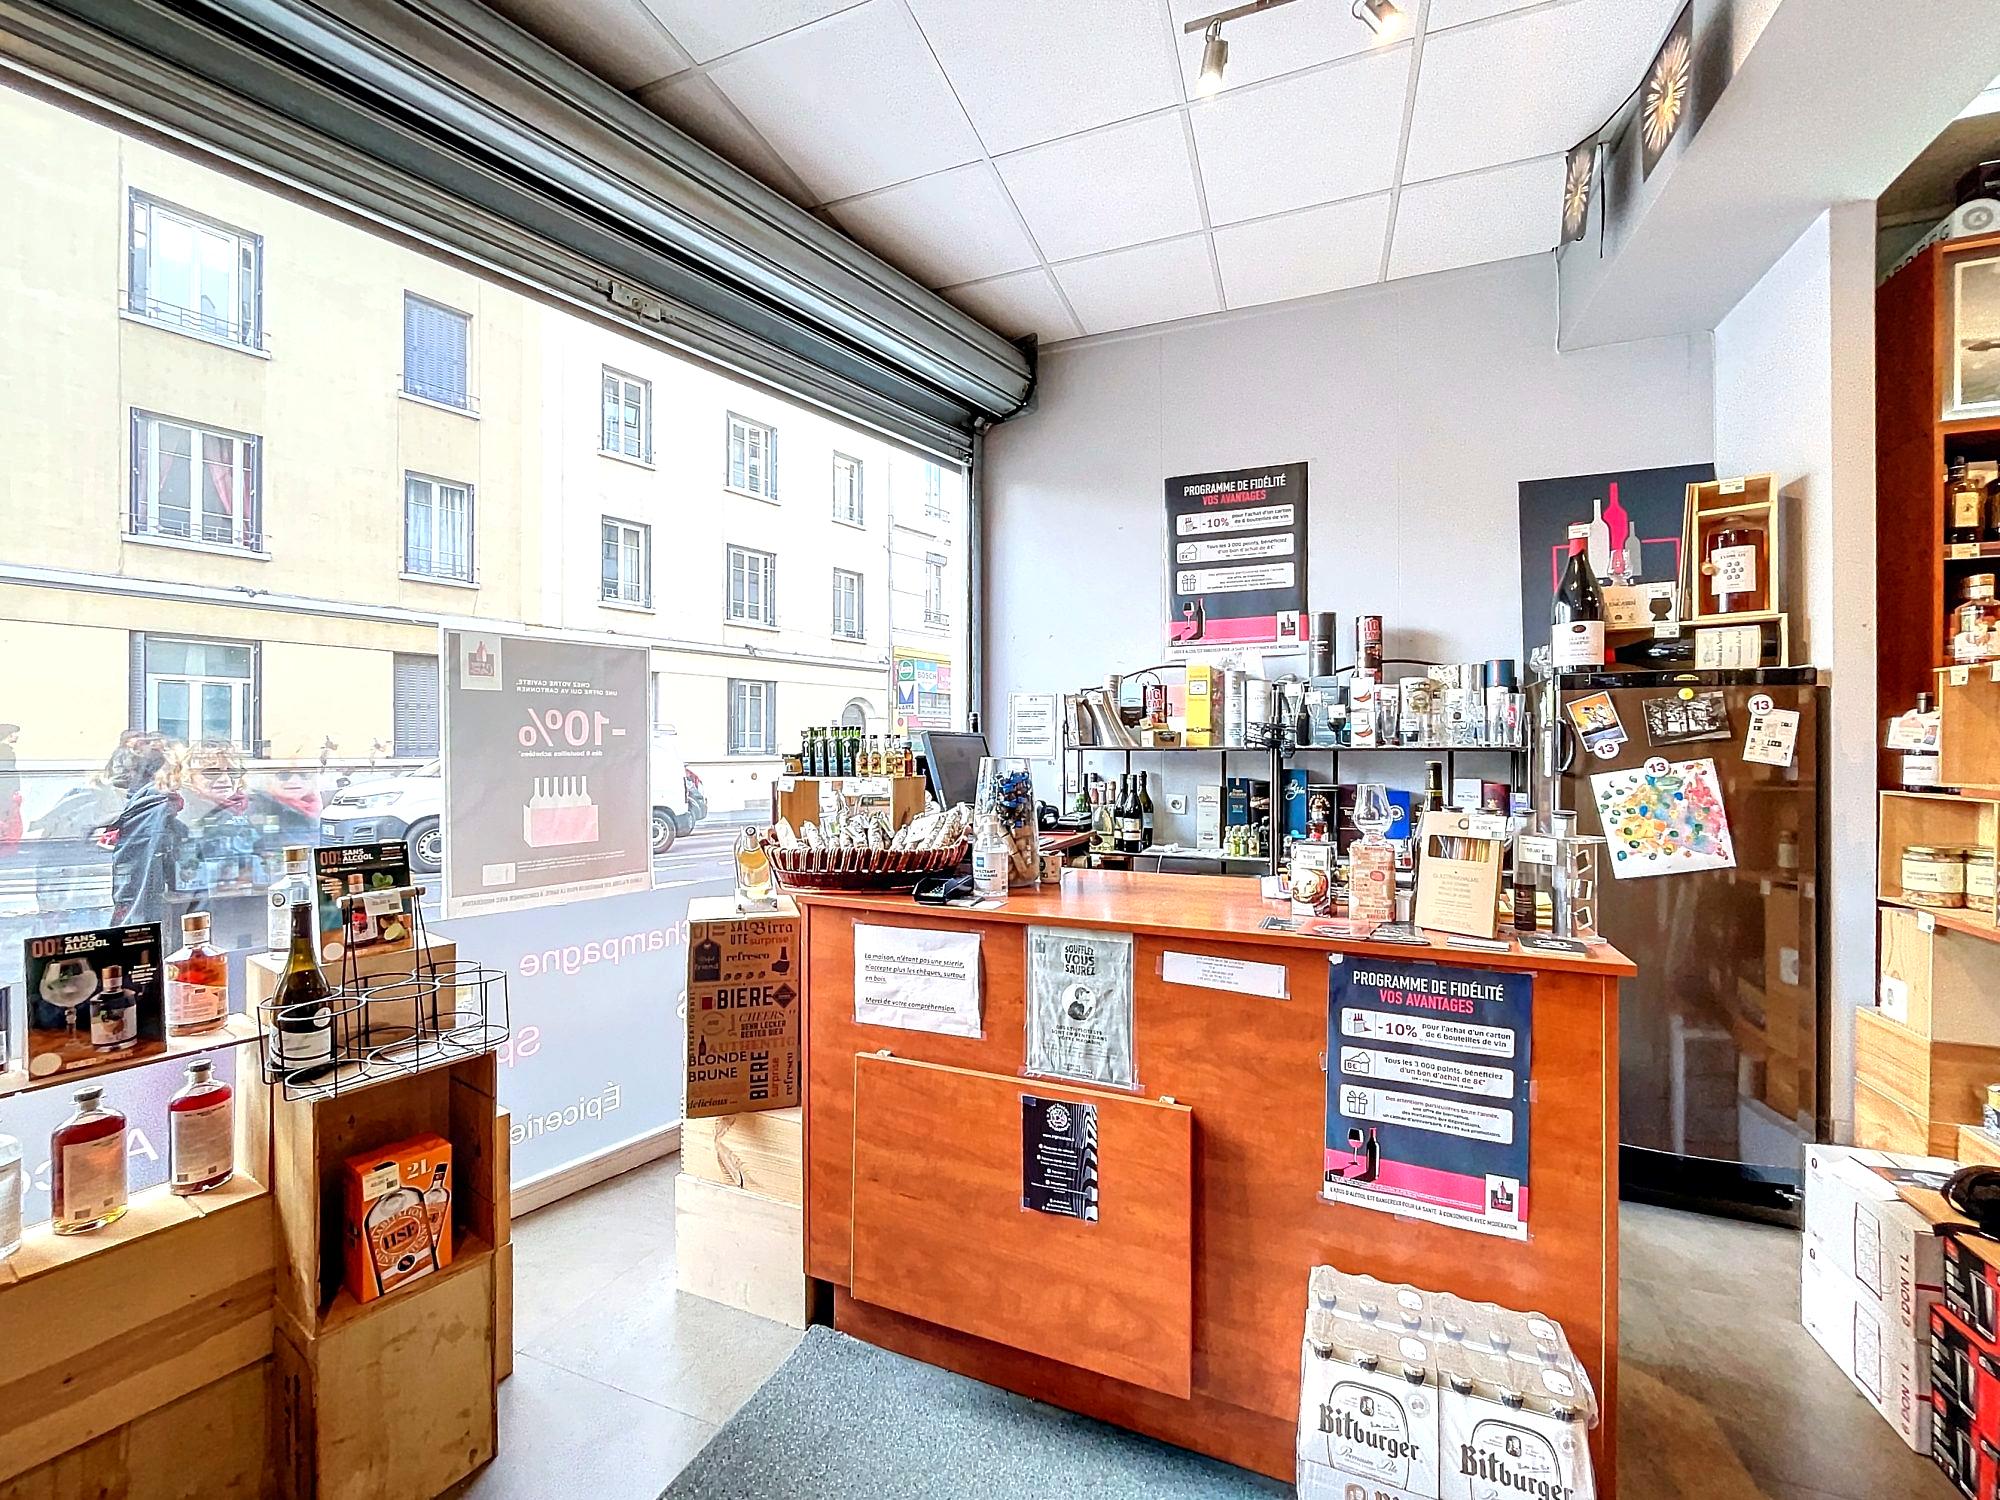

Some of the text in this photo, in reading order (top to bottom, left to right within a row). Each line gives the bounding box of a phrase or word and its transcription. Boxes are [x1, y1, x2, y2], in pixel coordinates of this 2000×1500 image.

[1184, 473, 1286, 496] PROGRAMME DE FIDÉLITÉ
[1202, 490, 1266, 506] VOS AVANTAGES
[1202, 518, 1229, 528] -10%
[1754, 701, 1769, 710] 13
[1598, 744, 1615, 754] 13
[1649, 762, 1666, 773] 13
[342, 848, 364, 856] SANS
[342, 853, 373, 861] ALCOOL
[730, 921, 793, 935] SAL Birra
[65, 934, 96, 944] SANS
[65, 939, 110, 951] ALCOOL
[730, 934, 748, 945] UTE
[1065, 944, 1094, 956] SOUFFLEZ
[726, 952, 769, 961] refresco
[873, 954, 895, 962] maison,
[897, 955, 918, 963] n'étant
[1064, 954, 1095, 966] VOUS
[944, 971, 966, 979] surtout
[1065, 964, 1096, 976] SAUREZ
[1353, 970, 1504, 1002] PROGRAMME DE FIDÉLITÉ
[1379, 988, 1474, 1014] VOS AVANTAGES
[760, 1020, 786, 1029] LECKER
[1378, 1022, 1418, 1038] -10%
[1441, 1025, 1466, 1034] l'achat
[1468, 1028, 1484, 1037] d'un
[1486, 1031, 1511, 1040] carton
[1443, 1034, 1480, 1045] bouteilles
[689, 1051, 747, 1066] BLONDE
[689, 1067, 737, 1082] BRUNE
[1384, 1057, 1400, 1065] Tous
[1421, 1062, 1435, 1070] 000
[1464, 1069, 1503, 1080] bénéficiez
[750, 1051, 769, 1100] BIERE
[1400, 1067, 1416, 1075] d'un
[1417, 1070, 1432, 1078] bon
[1433, 1072, 1460, 1083] d'achat
[1462, 1076, 1471, 1084] de
[407, 1158, 432, 1180] 2L
[382, 1221, 419, 1250] HSE
[1318, 1402, 1419, 1460] Bitburger
[1460, 1444, 1574, 1500] Bitburger
